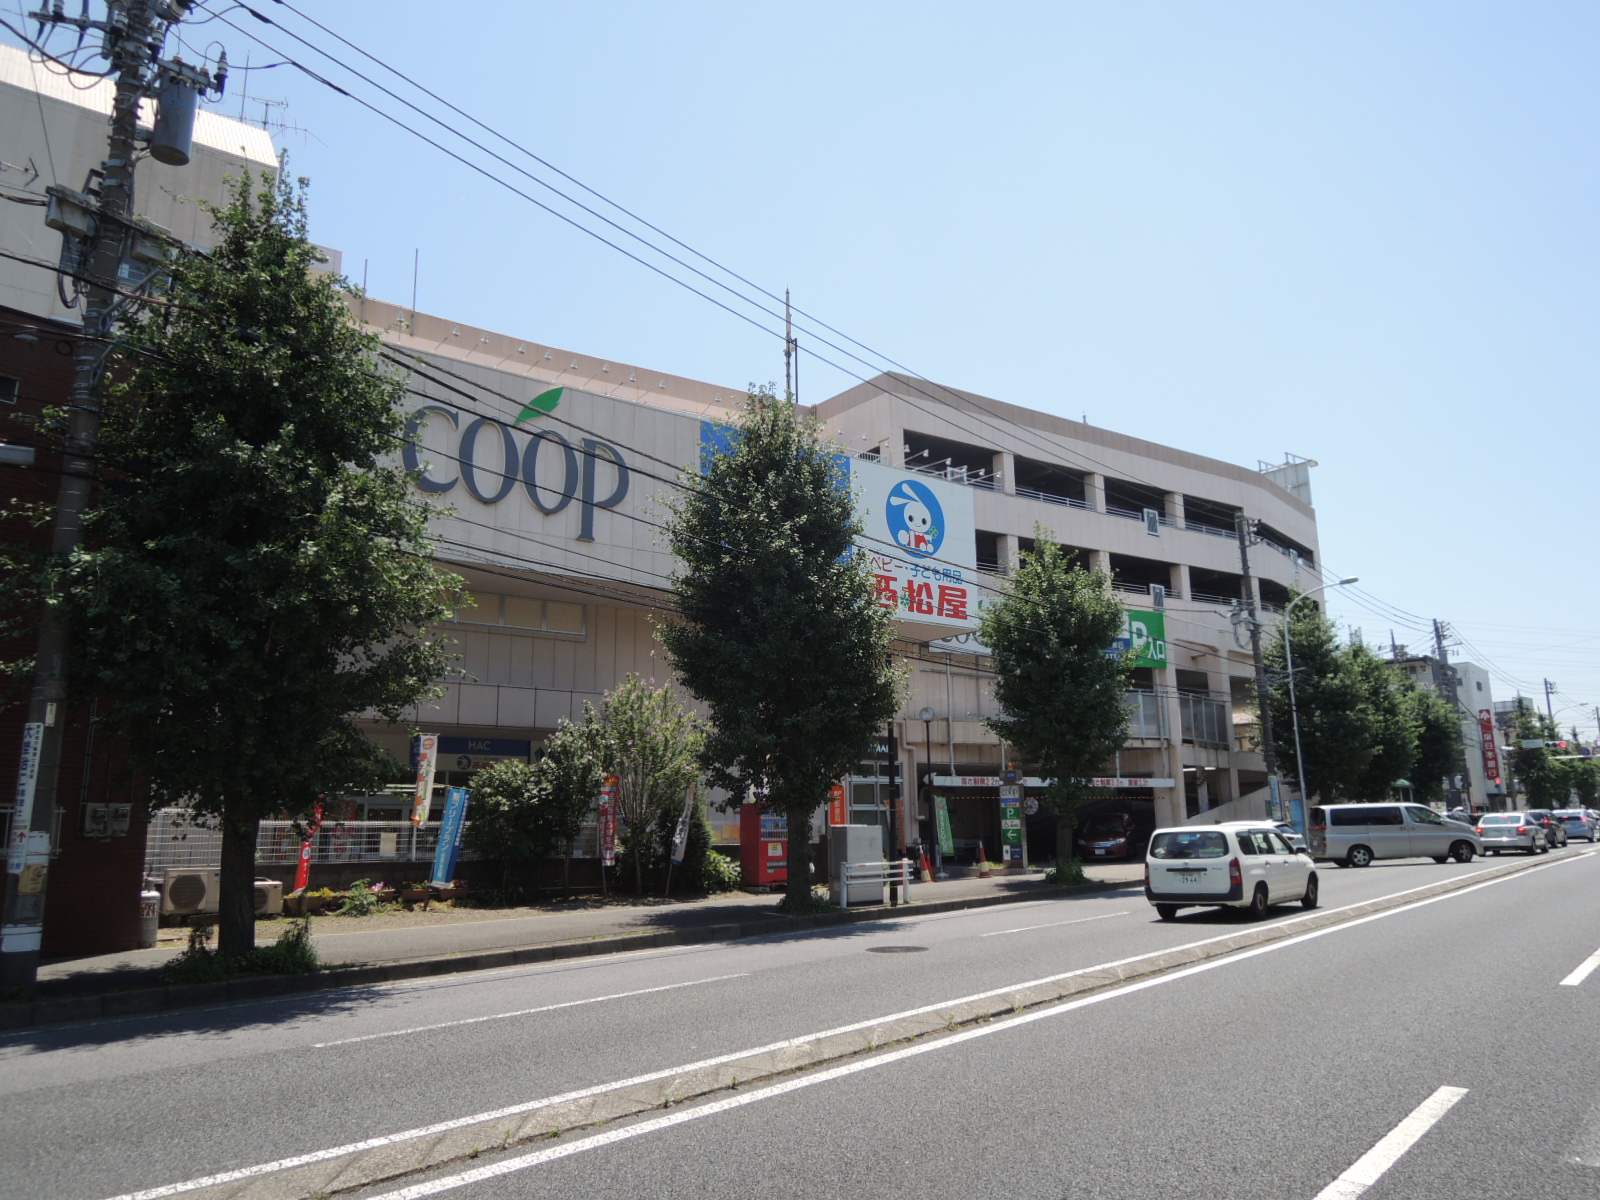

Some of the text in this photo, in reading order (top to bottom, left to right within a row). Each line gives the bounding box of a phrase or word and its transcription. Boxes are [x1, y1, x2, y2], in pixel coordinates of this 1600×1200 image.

[868, 573, 969, 621] 西松屋
[1131, 621, 1165, 661] P 入口
[468, 741, 491, 751] HAC
[440, 792, 463, 851] 新フリープラン
[1006, 808, 1014, 819] P
